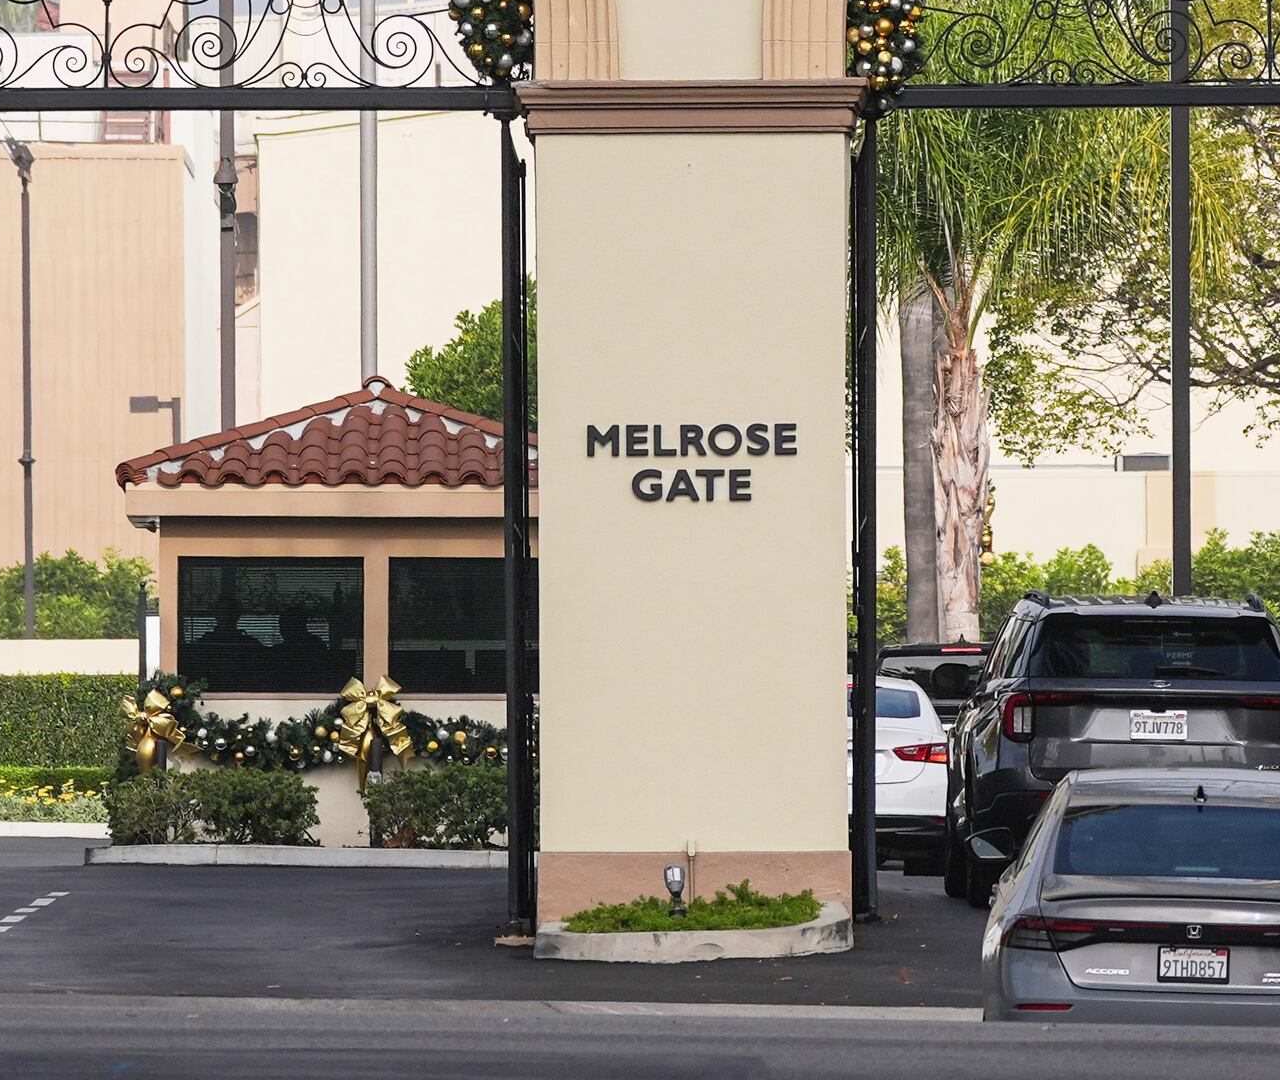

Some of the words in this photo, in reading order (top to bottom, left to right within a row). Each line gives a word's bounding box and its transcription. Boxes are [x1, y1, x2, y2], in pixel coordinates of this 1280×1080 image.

[586, 423, 798, 457] MELROSE
[631, 469, 752, 502] GATE
[1134, 721, 1184, 735] 9TJV778
[1084, 967, 1130, 975] ACCORD
[1163, 959, 1225, 978] 9THD857
